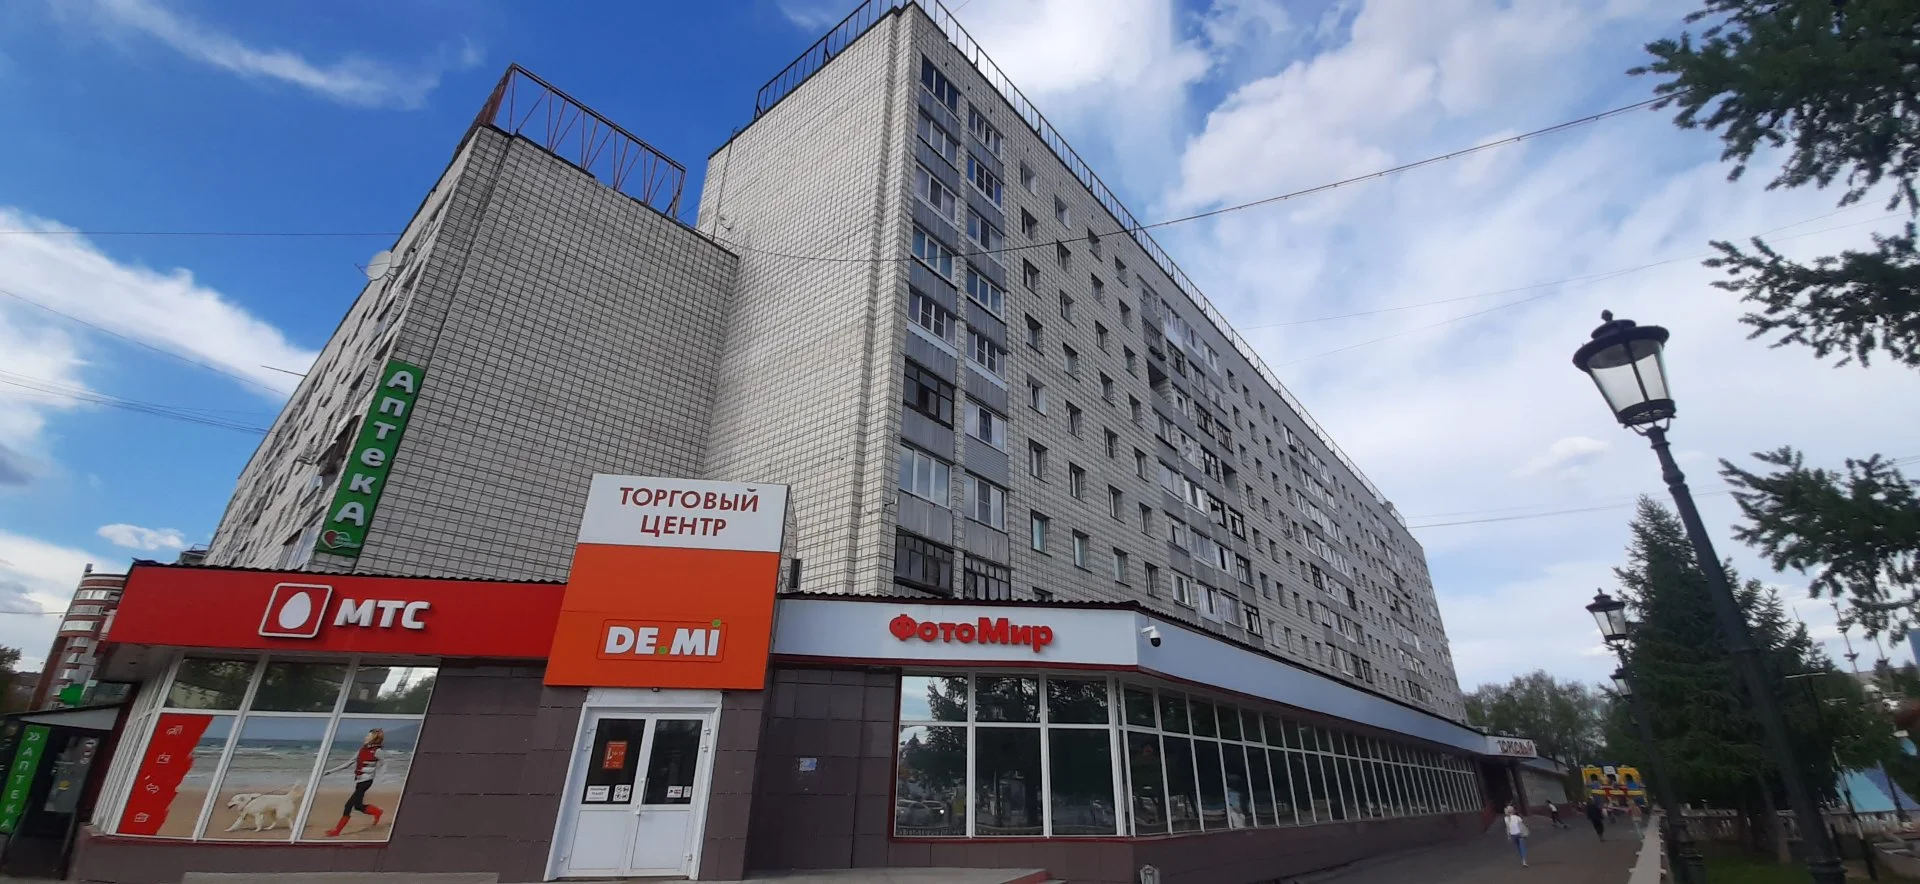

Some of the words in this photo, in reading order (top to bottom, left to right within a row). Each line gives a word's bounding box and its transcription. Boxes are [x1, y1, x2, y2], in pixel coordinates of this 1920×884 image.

[619, 487, 759, 512] ТОРГОВЫЙ
[640, 515, 727, 537] ЦЕНТР
[333, 598, 431, 630] МТС
[889, 614, 1053, 653] ФотоМир
[1, 747, 33, 830] АПТЕКА
